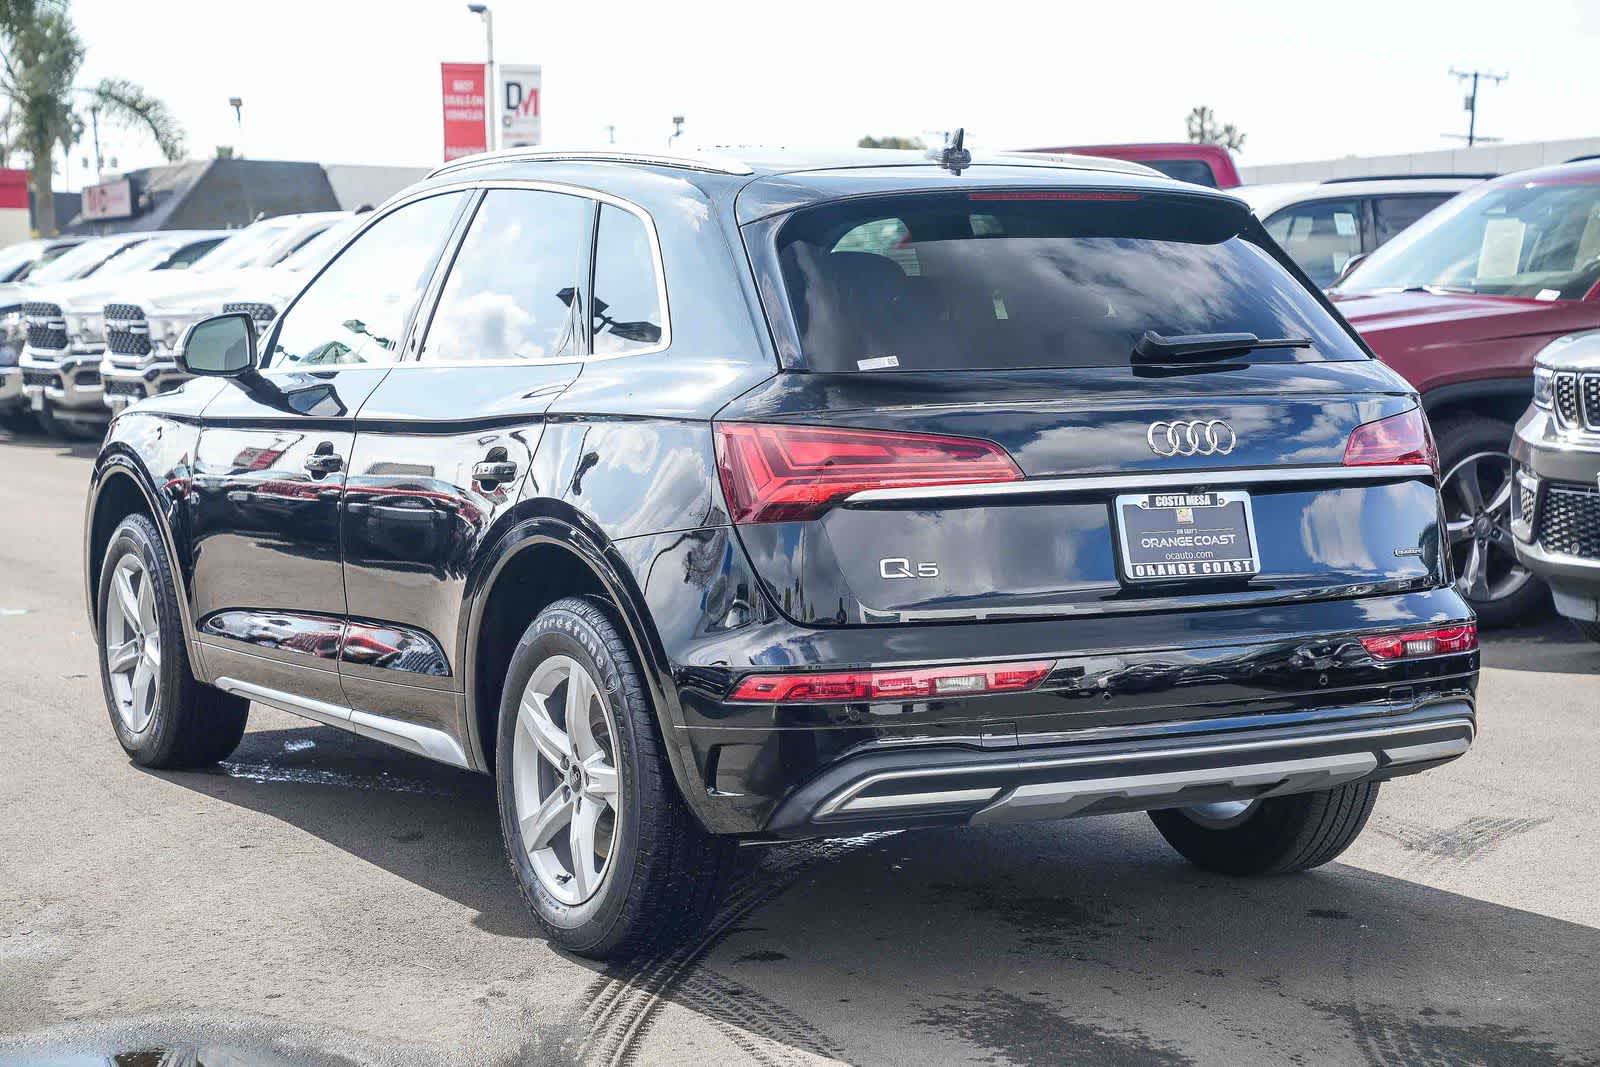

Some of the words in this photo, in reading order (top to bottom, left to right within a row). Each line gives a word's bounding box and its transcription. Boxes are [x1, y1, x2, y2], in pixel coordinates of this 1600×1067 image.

[1155, 494, 1185, 507] COSTA
[1186, 493, 1211, 506] MESA
[1141, 536, 1194, 548] ORANGE
[1194, 534, 1237, 547] COAST
[1165, 549, 1214, 561] ocauto.com
[879, 557, 939, 579] Q5
[1135, 563, 1197, 577] ORANGE
[1202, 560, 1252, 573] COAST
[535, 616, 605, 669] Firestone
